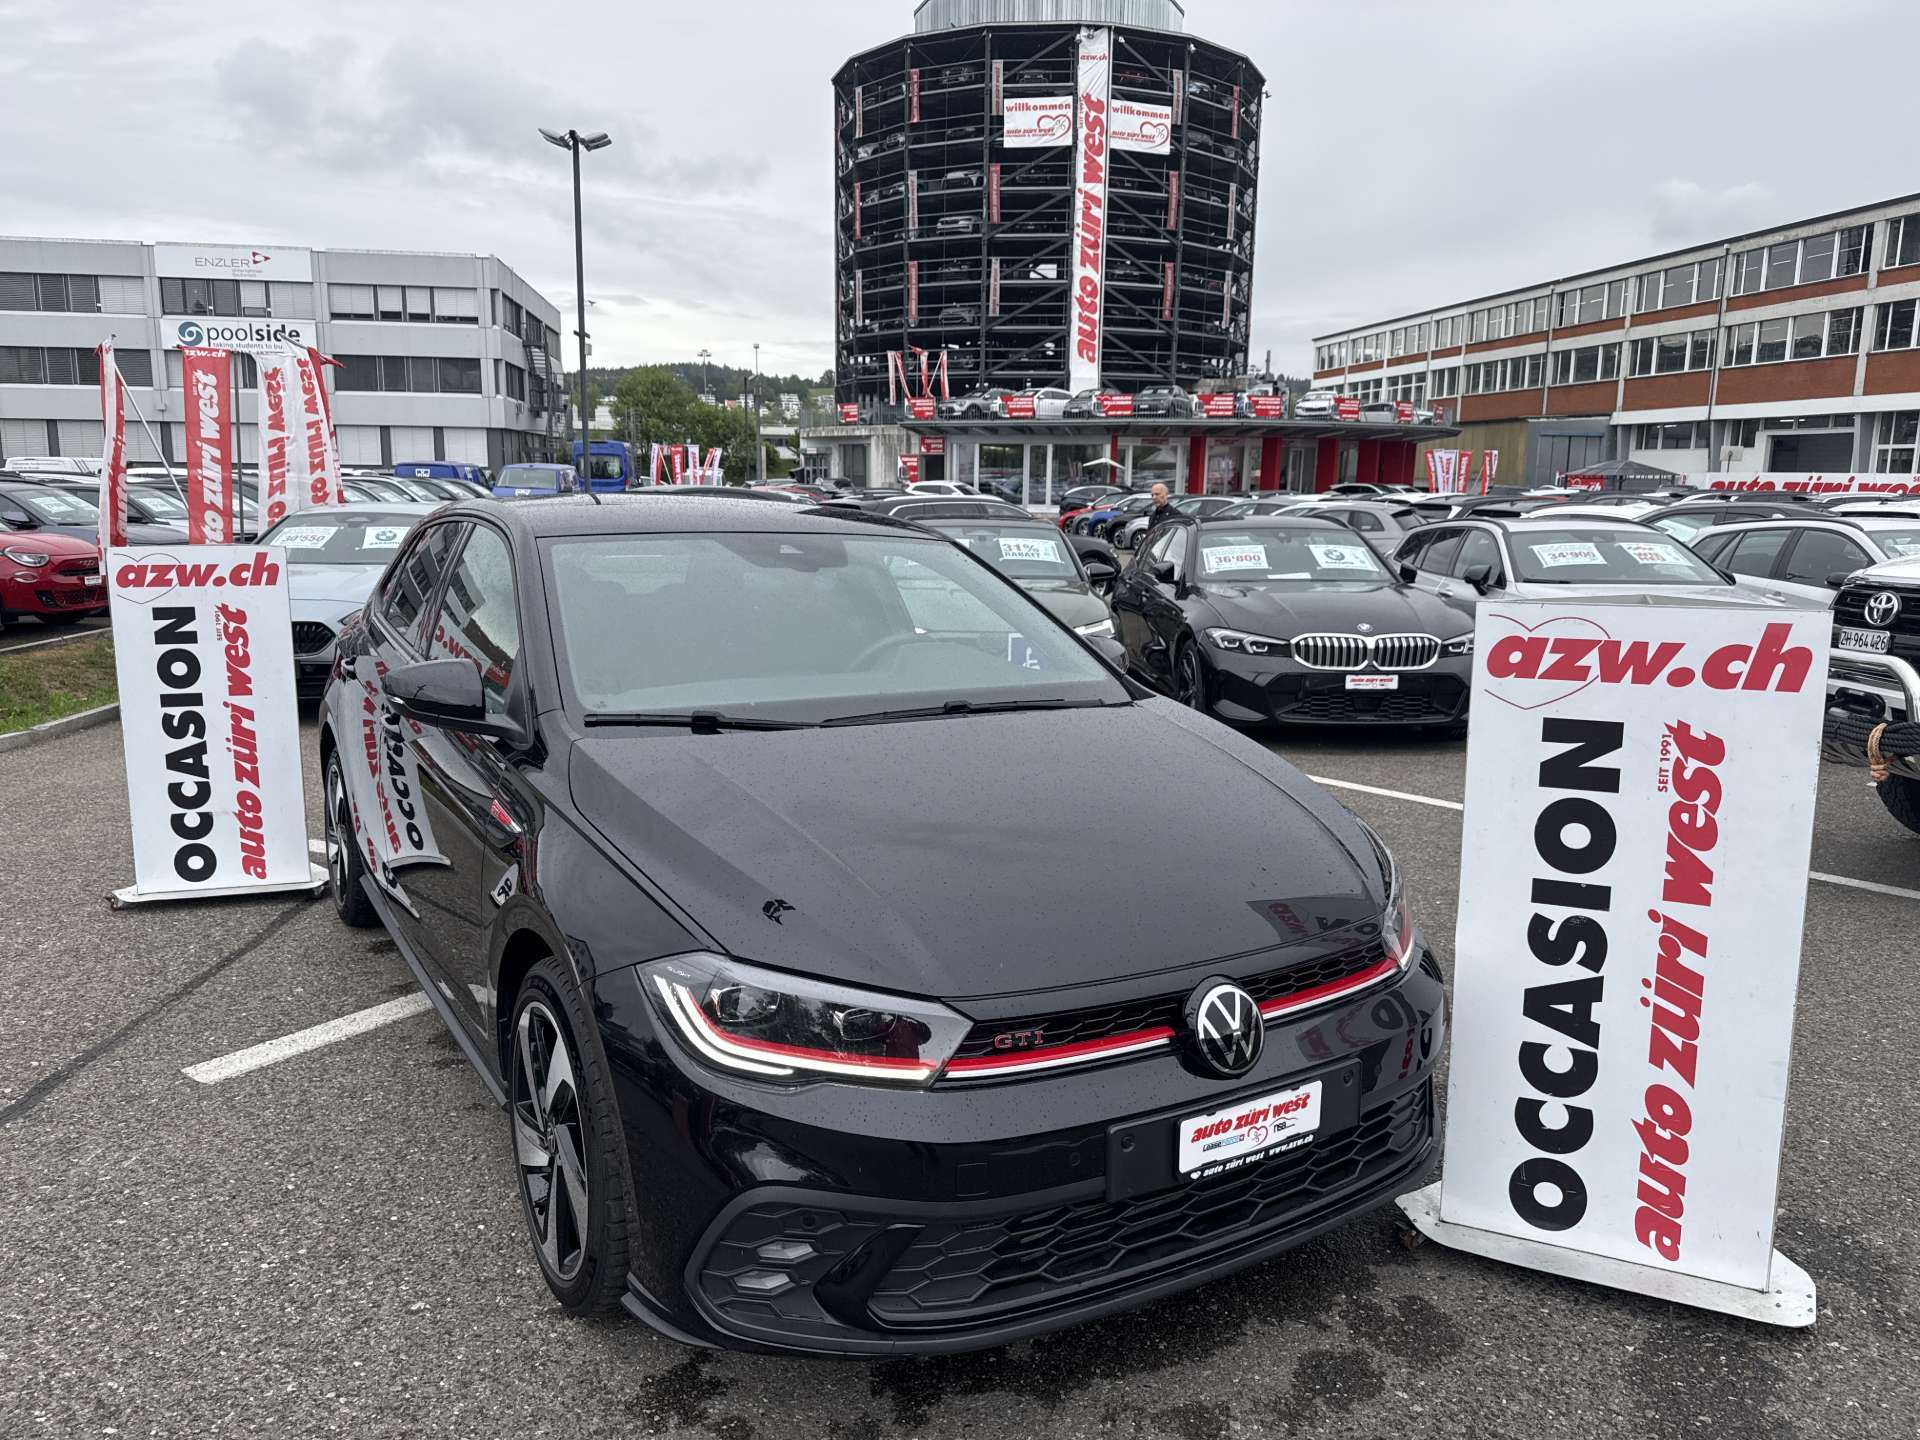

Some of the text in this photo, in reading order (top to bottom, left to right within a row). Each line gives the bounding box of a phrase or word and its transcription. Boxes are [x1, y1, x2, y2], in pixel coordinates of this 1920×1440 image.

[1006, 102, 1071, 112] willkommen
[1112, 105, 1170, 120] willkommen
[1075, 93, 1105, 364] auto züri west
[194, 256, 250, 268] ENZLER
[207, 323, 301, 347] poolside
[213, 342, 235, 350] taking
[235, 342, 264, 350] students
[194, 369, 221, 440] west
[196, 440, 223, 509] züri
[116, 552, 280, 588] azw.ch
[1486, 622, 1814, 692] azw.ch
[152, 606, 217, 883] OCCASION
[214, 602, 267, 880] auto züri west
[1657, 733, 1673, 793] SEIT 1991
[1509, 717, 1625, 1231] OCCASION
[1631, 719, 1726, 1262] auto züri west
[994, 1030, 1044, 1049] GTI
[1191, 1093, 1311, 1143] auto züri west
[1203, 1165, 1224, 1177] auto
[1225, 1157, 1244, 1171] züri
[1245, 1151, 1265, 1164] west
